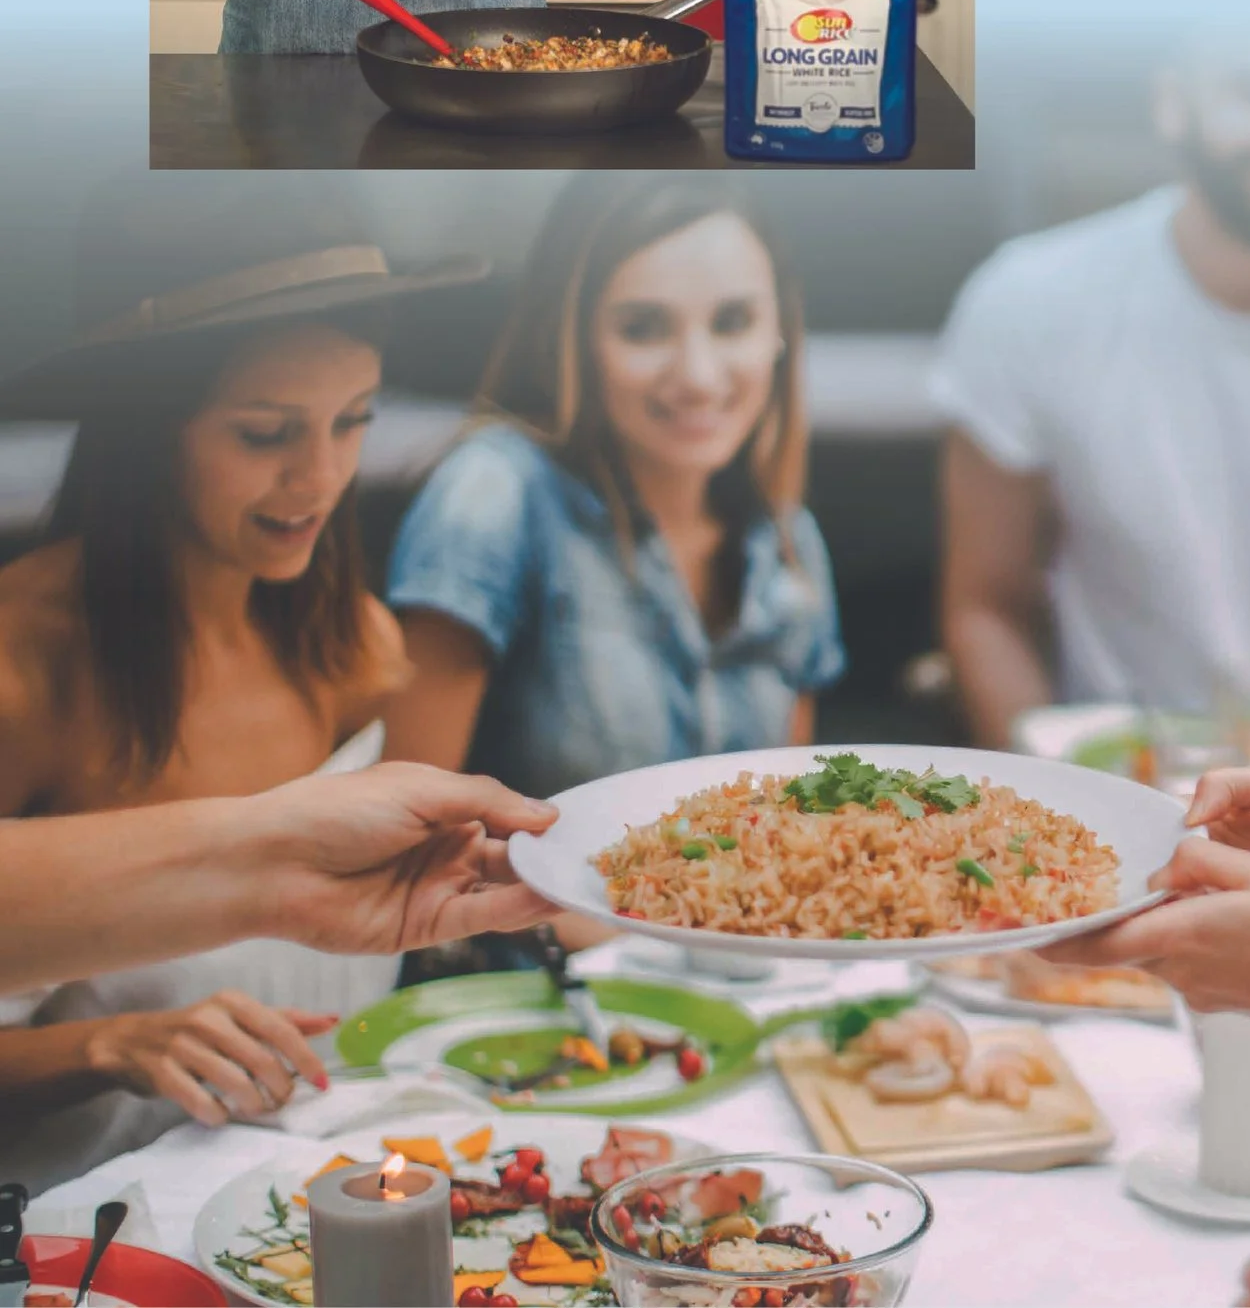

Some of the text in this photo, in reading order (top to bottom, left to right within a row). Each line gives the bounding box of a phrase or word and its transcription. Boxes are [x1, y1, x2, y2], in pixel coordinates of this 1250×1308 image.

[763, 49, 877, 65] LONG GRAIN
[793, 69, 851, 77] WHITE RICE
